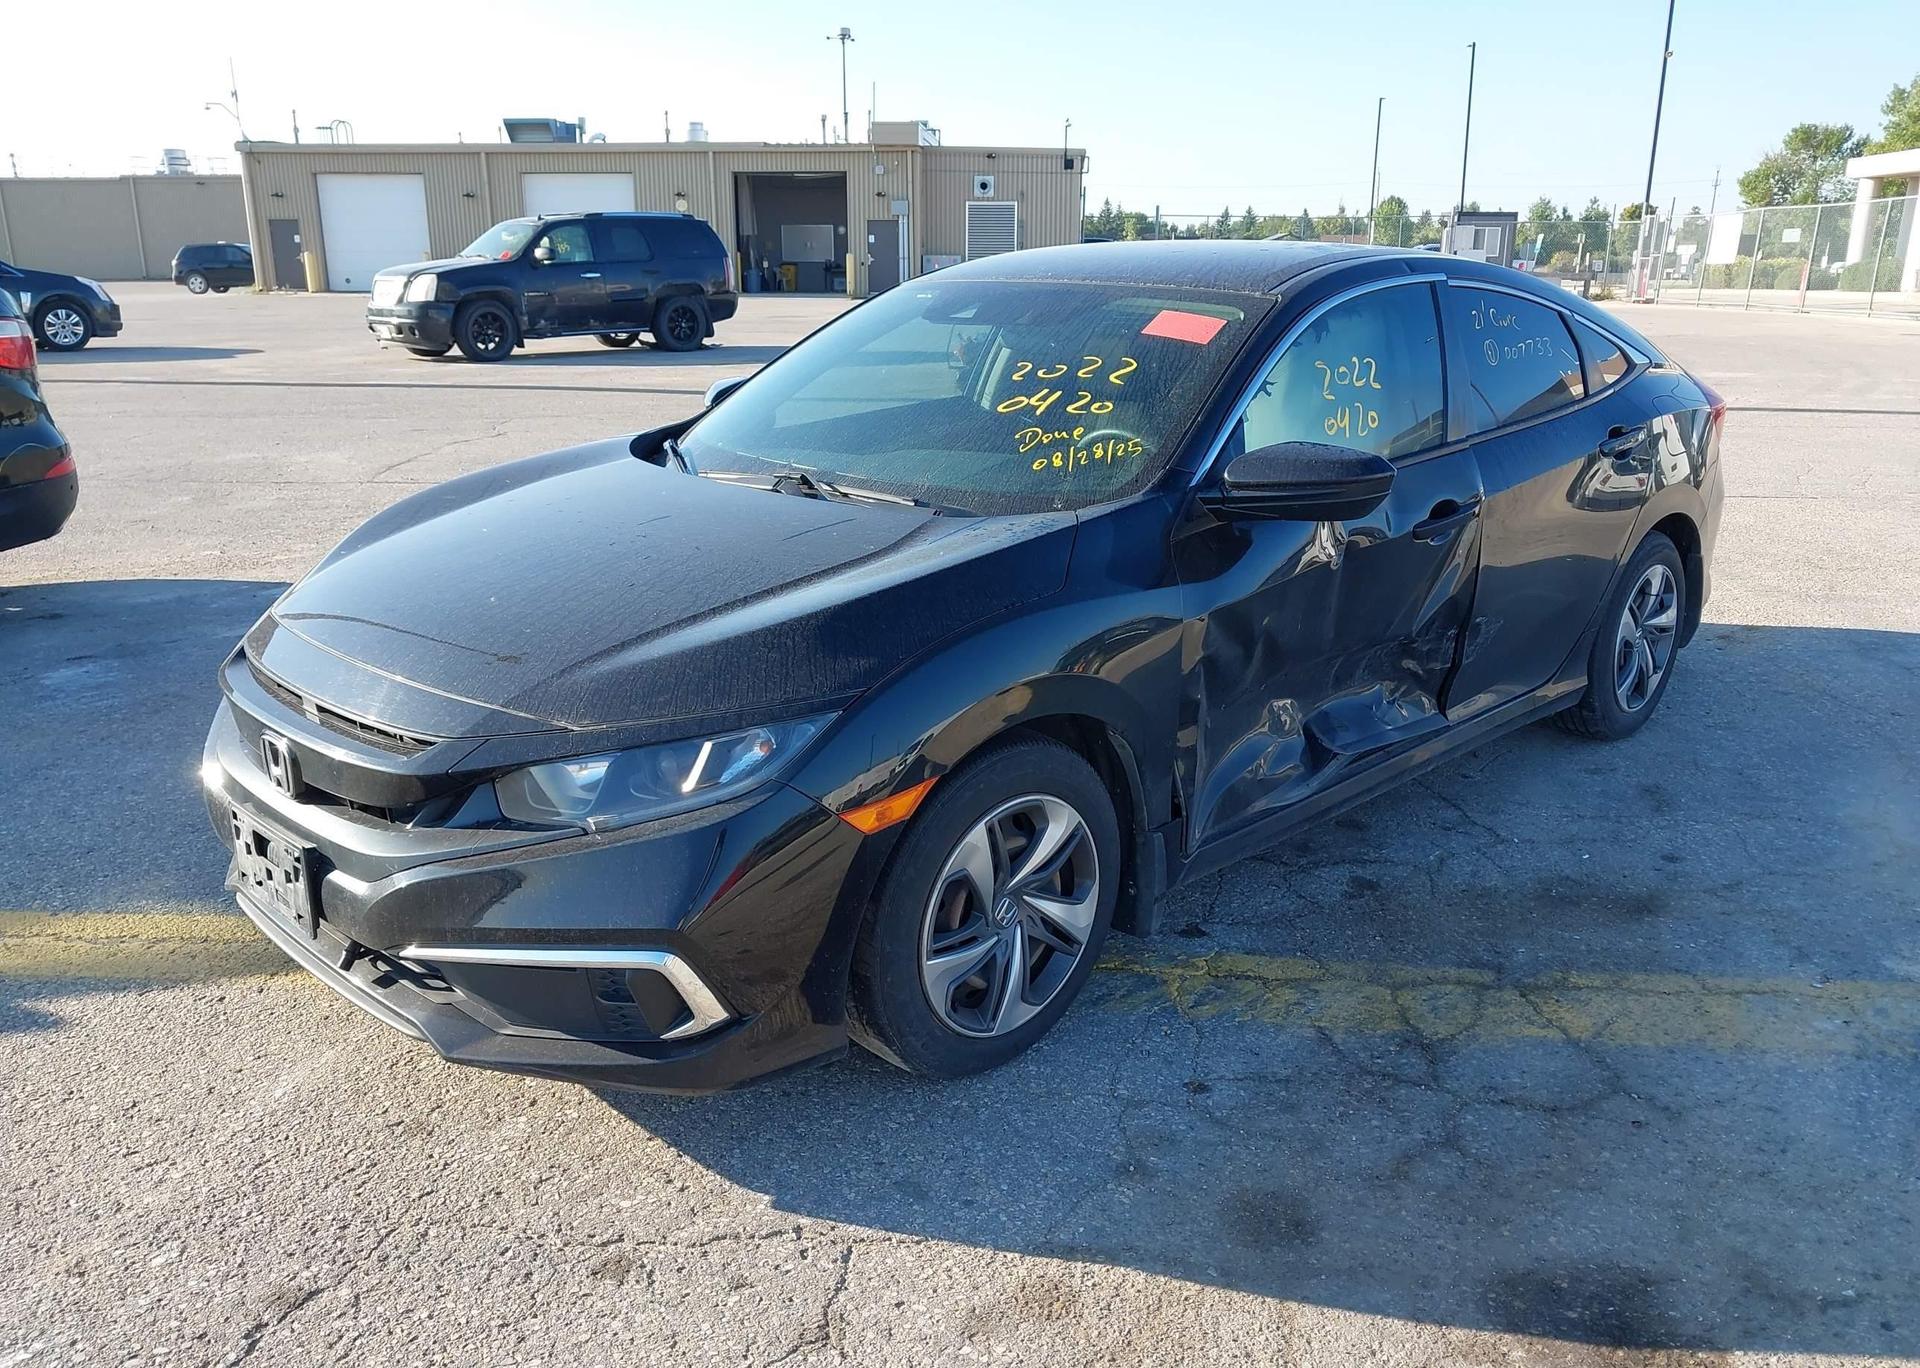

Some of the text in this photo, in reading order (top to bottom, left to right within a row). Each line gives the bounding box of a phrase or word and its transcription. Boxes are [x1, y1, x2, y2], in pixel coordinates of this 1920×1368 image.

[1012, 356, 1138, 385] 2022
[1314, 356, 1382, 400] 2022
[1324, 402, 1379, 438] 0420
[1015, 426, 1085, 453] Done
[1032, 438, 1143, 472] 08/28/25
